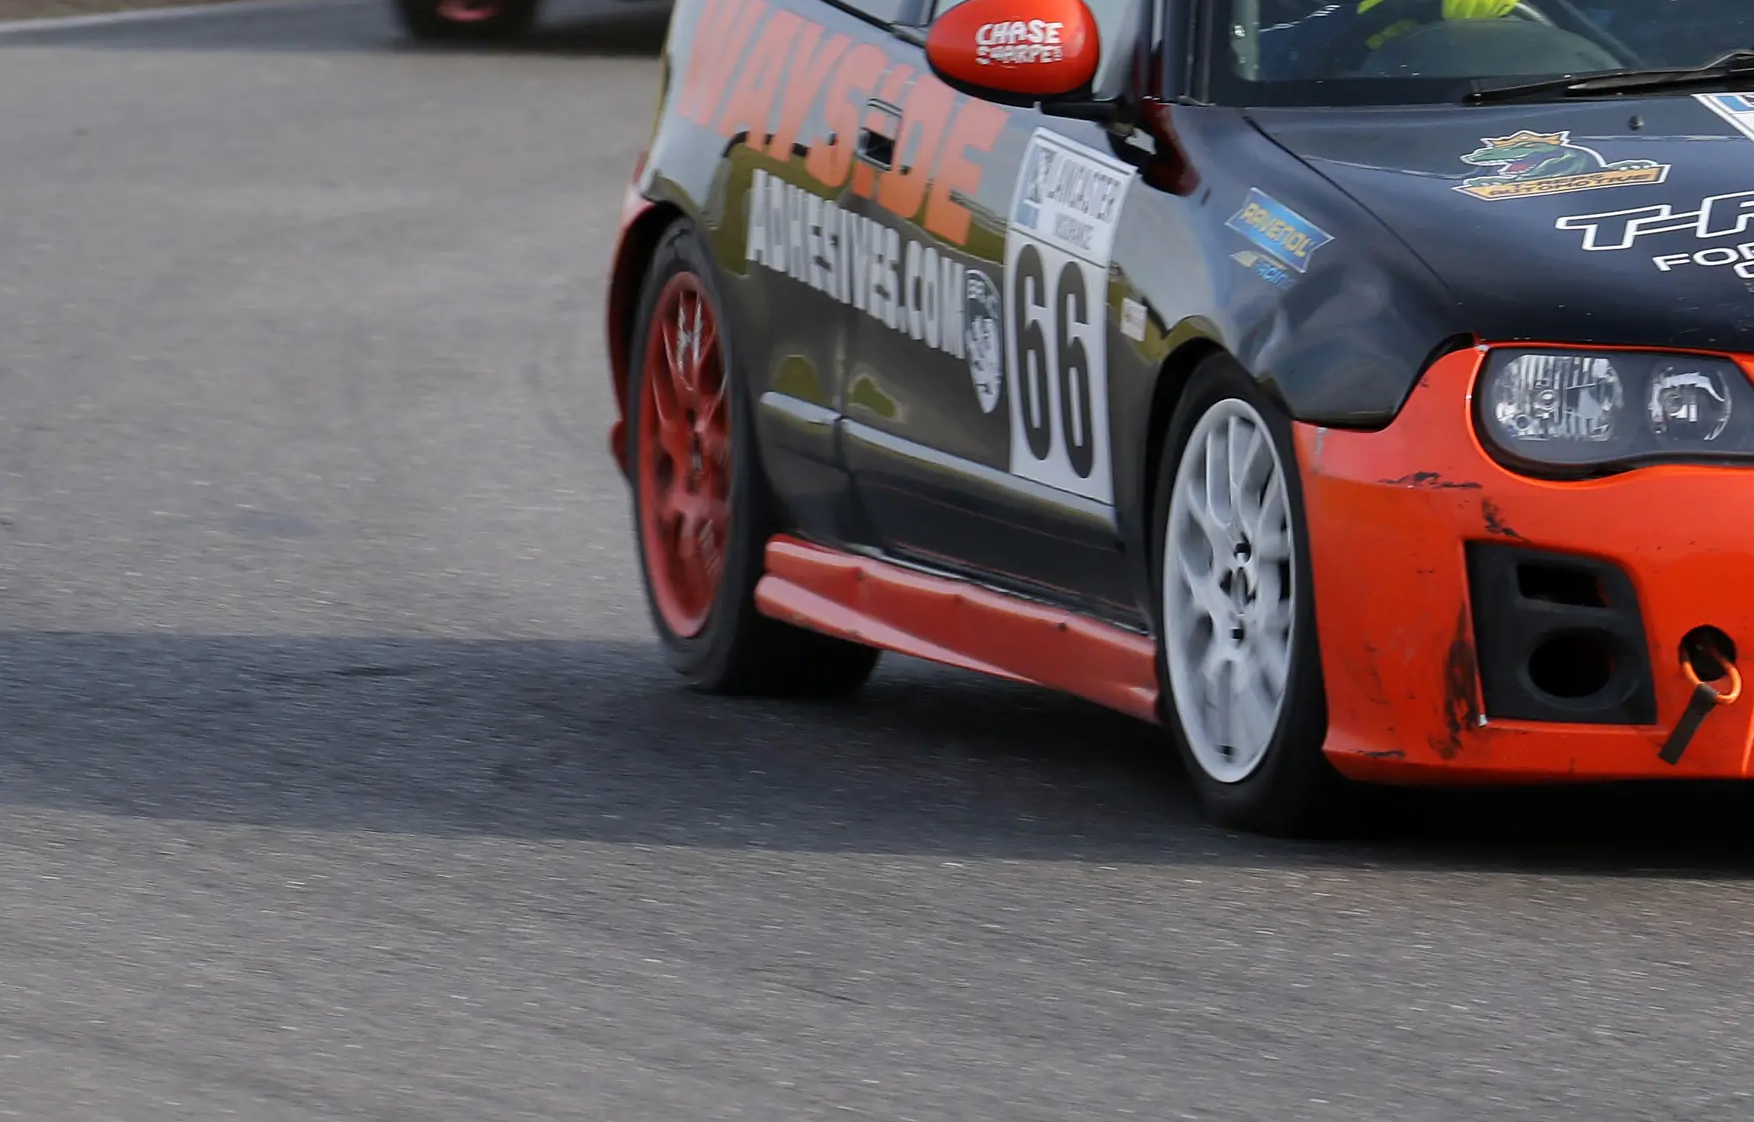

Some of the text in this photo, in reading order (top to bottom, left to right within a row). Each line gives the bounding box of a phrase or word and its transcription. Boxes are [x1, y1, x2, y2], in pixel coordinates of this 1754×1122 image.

[975, 19, 1064, 46] CHASE
[744, 168, 966, 360] ADHESIVES.COM
[1014, 243, 1095, 479] 66
